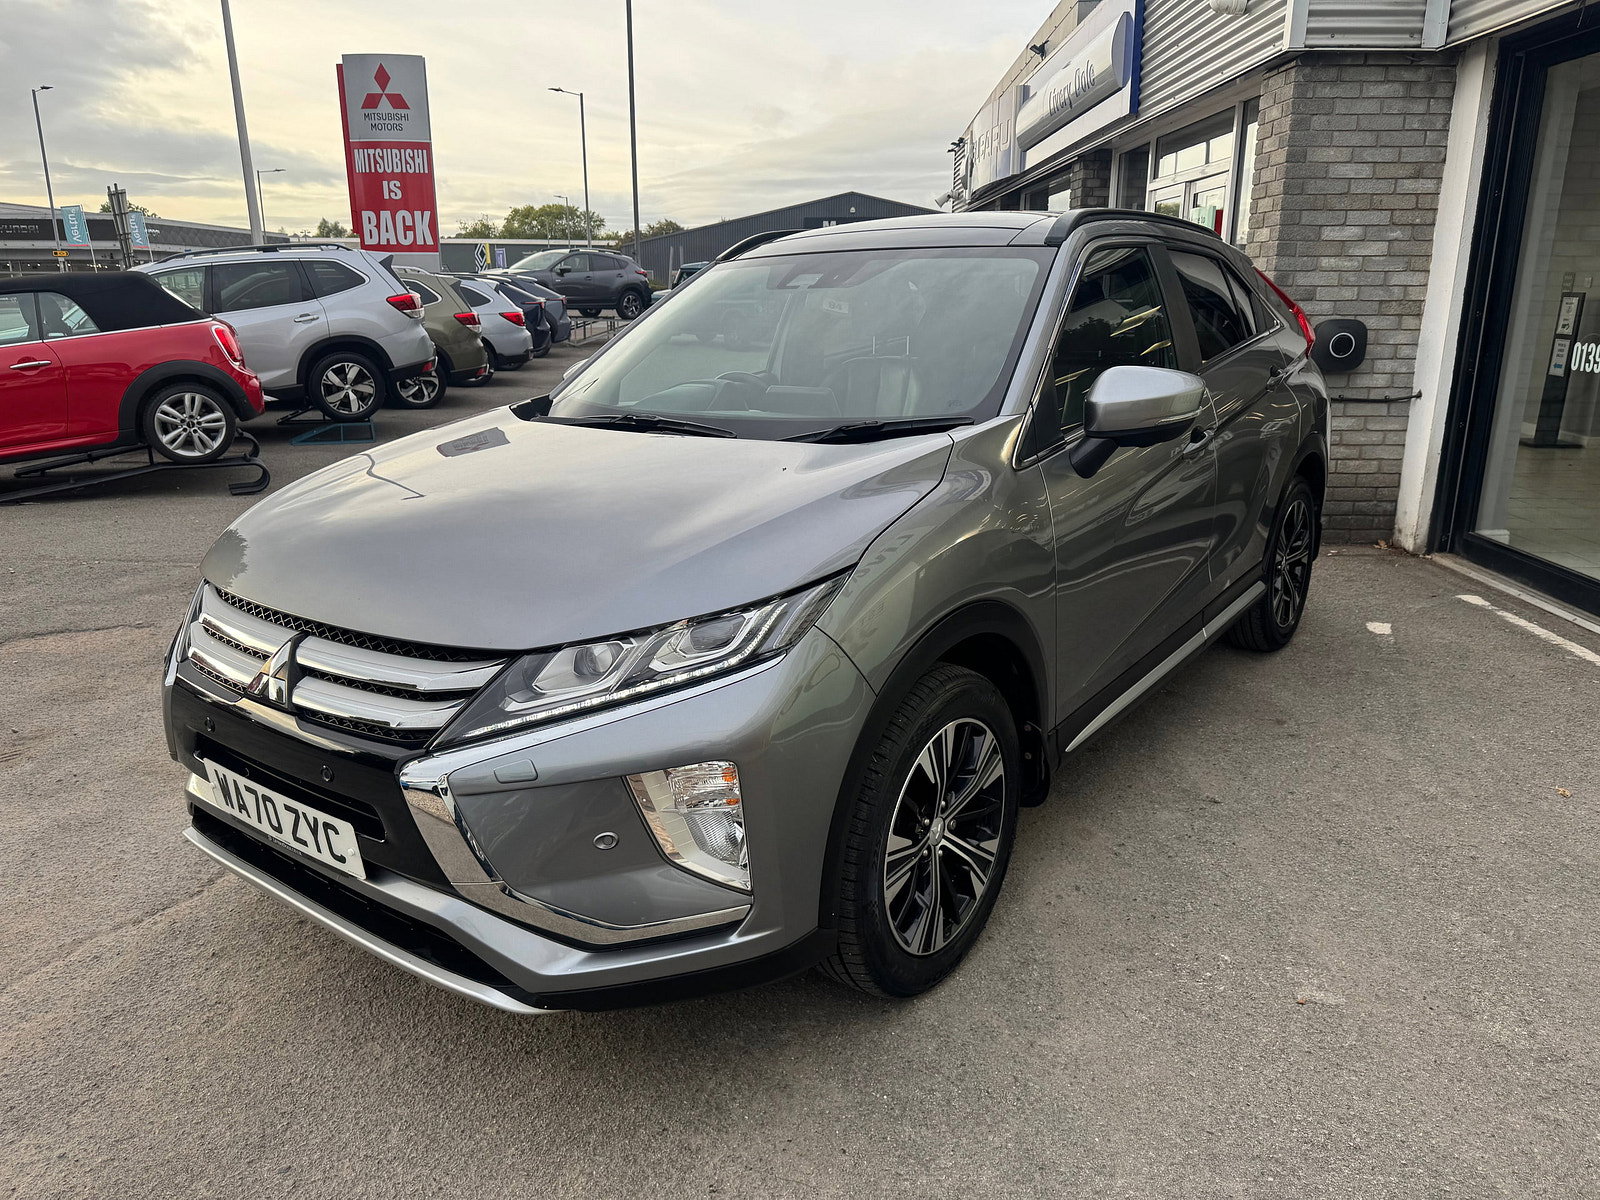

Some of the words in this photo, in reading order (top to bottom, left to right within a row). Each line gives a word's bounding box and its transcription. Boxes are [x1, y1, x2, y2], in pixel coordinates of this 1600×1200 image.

[1048, 82, 1073, 116] Livery
[363, 112, 410, 122] MITSUBISHI
[370, 122, 404, 131] MOTORS
[353, 148, 429, 174] MITSUBISHI
[382, 180, 402, 200] IS
[0, 225, 39, 233] YUNDAI
[361, 209, 434, 246] BACK
[1571, 341, 1600, 374] 0139
[213, 768, 283, 835] WA70
[283, 803, 347, 865] ZYC
